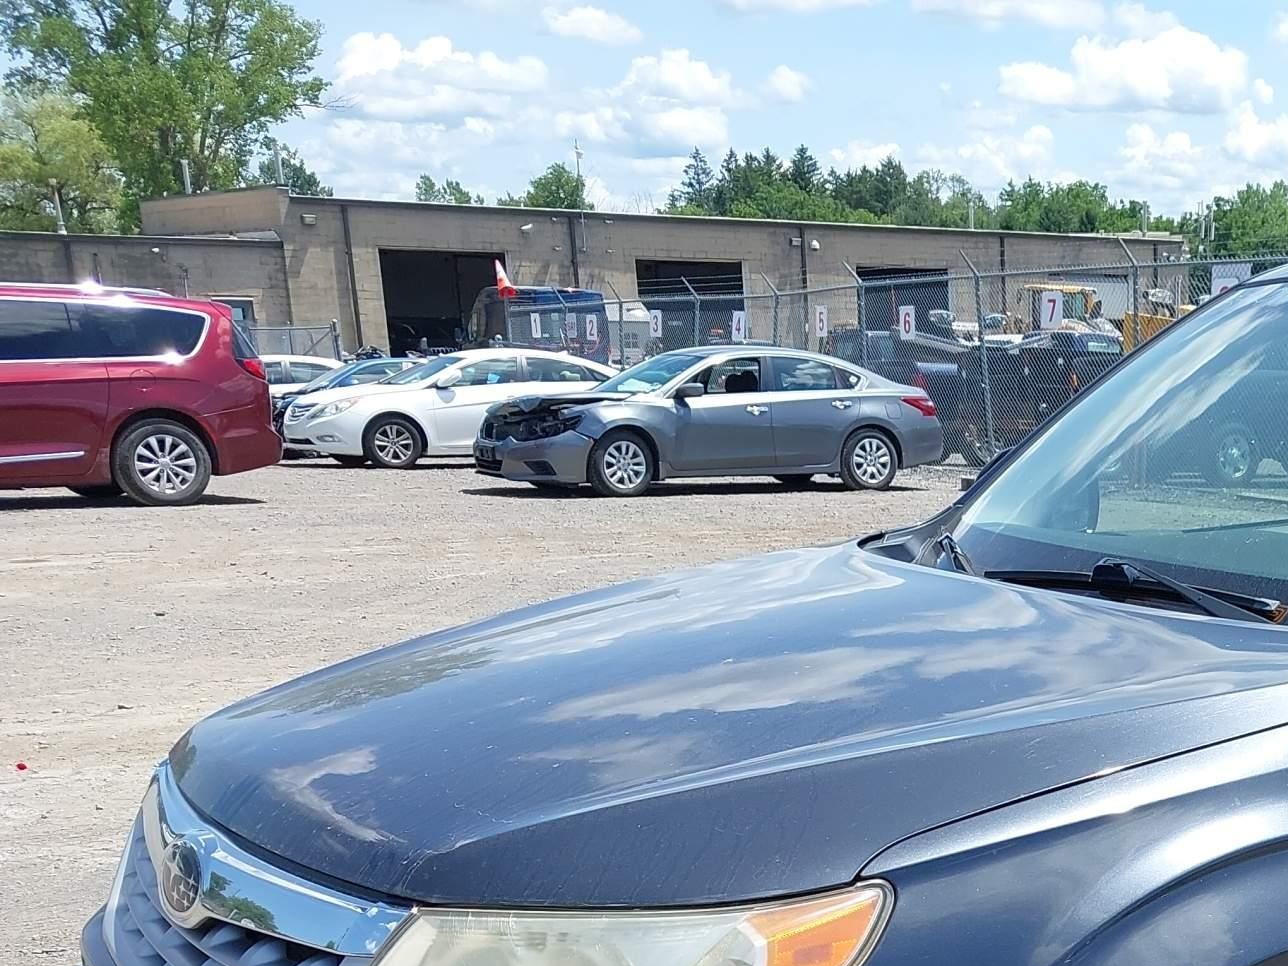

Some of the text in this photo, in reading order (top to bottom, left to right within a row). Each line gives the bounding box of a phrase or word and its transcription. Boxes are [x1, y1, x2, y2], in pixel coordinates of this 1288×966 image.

[1047, 298, 1057, 322] 7
[588, 319, 595, 337] 2
[652, 315, 659, 333] 3
[735, 316, 741, 335] 4
[818, 311, 825, 332] 5
[903, 312, 911, 334] 6
